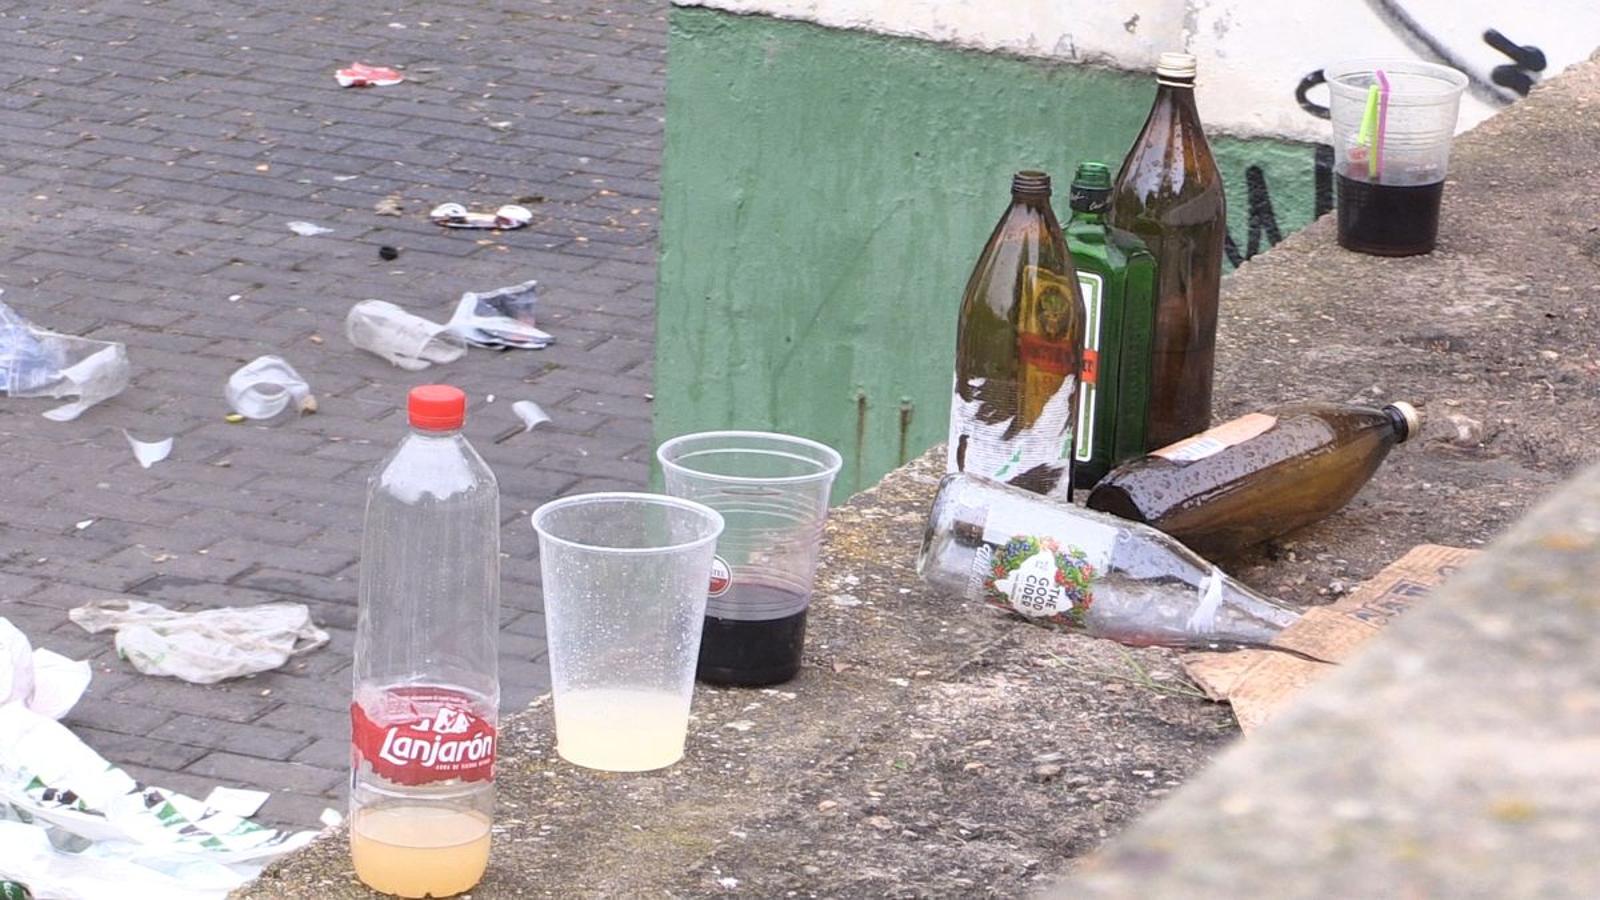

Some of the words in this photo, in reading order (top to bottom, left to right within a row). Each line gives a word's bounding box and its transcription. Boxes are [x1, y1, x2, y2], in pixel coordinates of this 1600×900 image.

[1022, 575, 1037, 607] CIDER
[1033, 577, 1050, 611] GOOD
[1045, 589, 1061, 609] THE
[379, 727, 492, 766] Lanjarón
